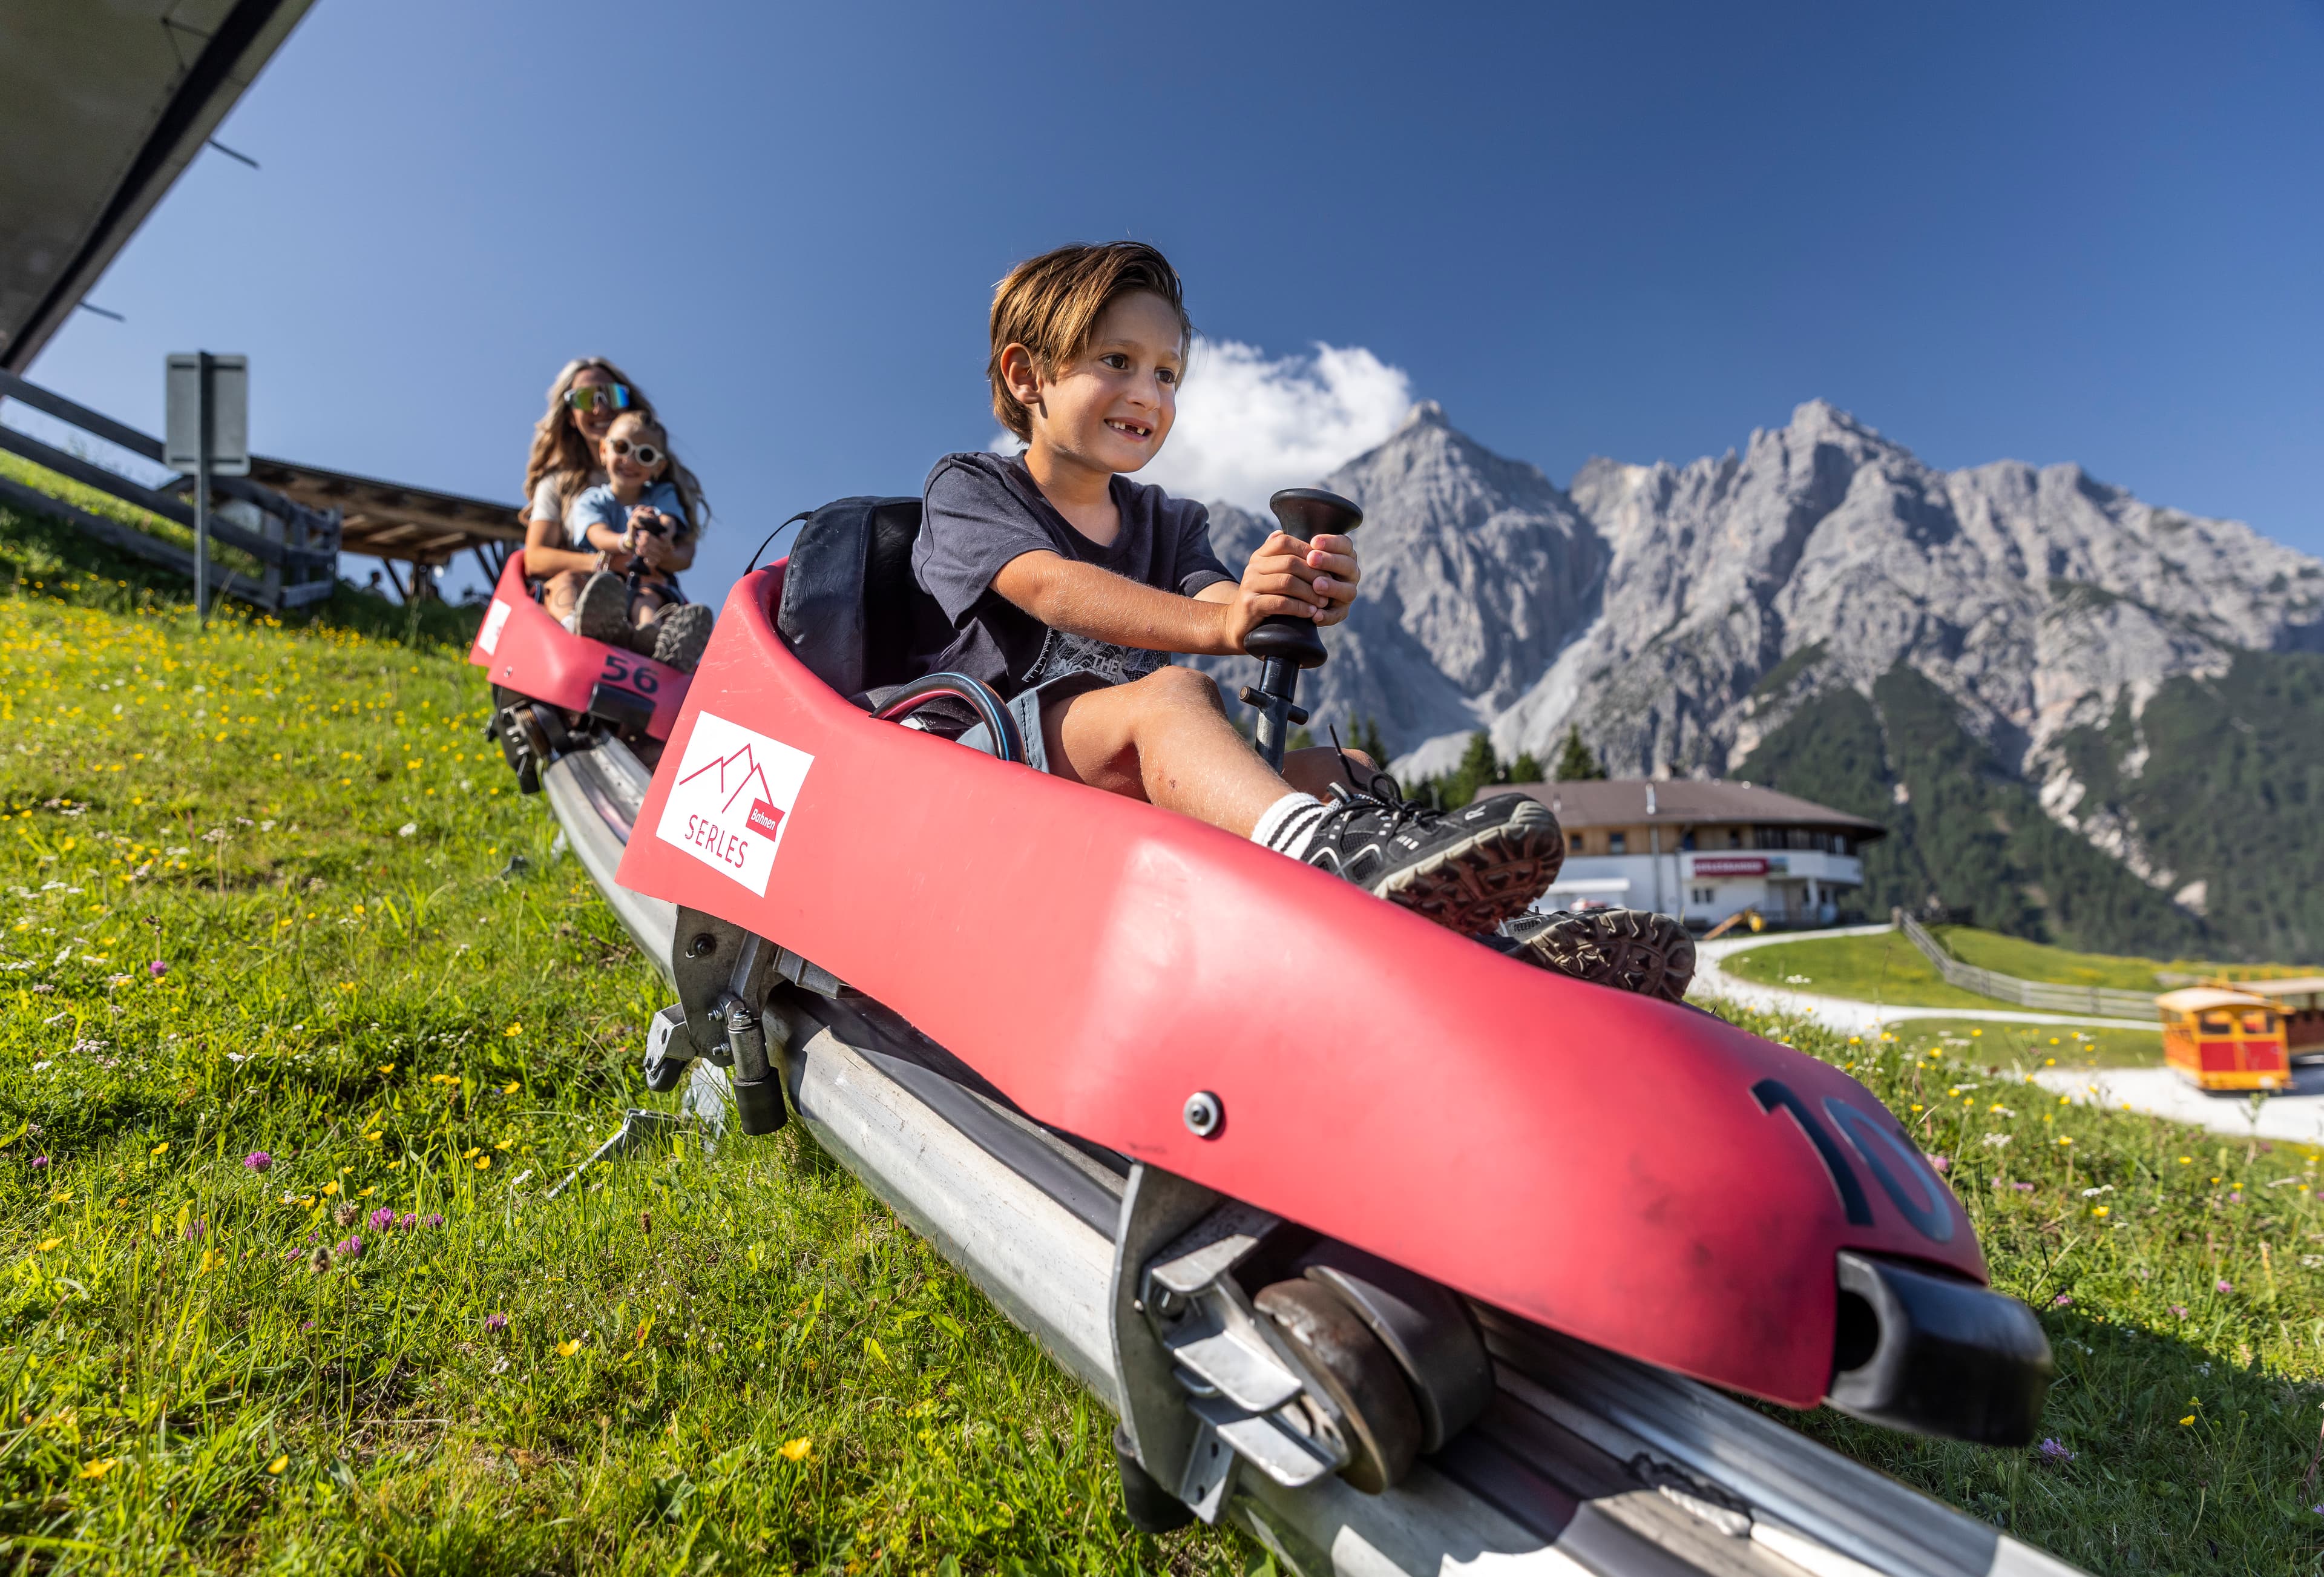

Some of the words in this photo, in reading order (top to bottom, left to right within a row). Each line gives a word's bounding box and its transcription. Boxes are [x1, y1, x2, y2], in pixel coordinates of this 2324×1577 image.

[601, 656, 658, 694] 56
[1092, 654, 1120, 675] THE
[750, 808, 776, 831] Bahnen
[684, 814, 748, 868] SERLES
[1748, 1078, 1955, 1244] 10
